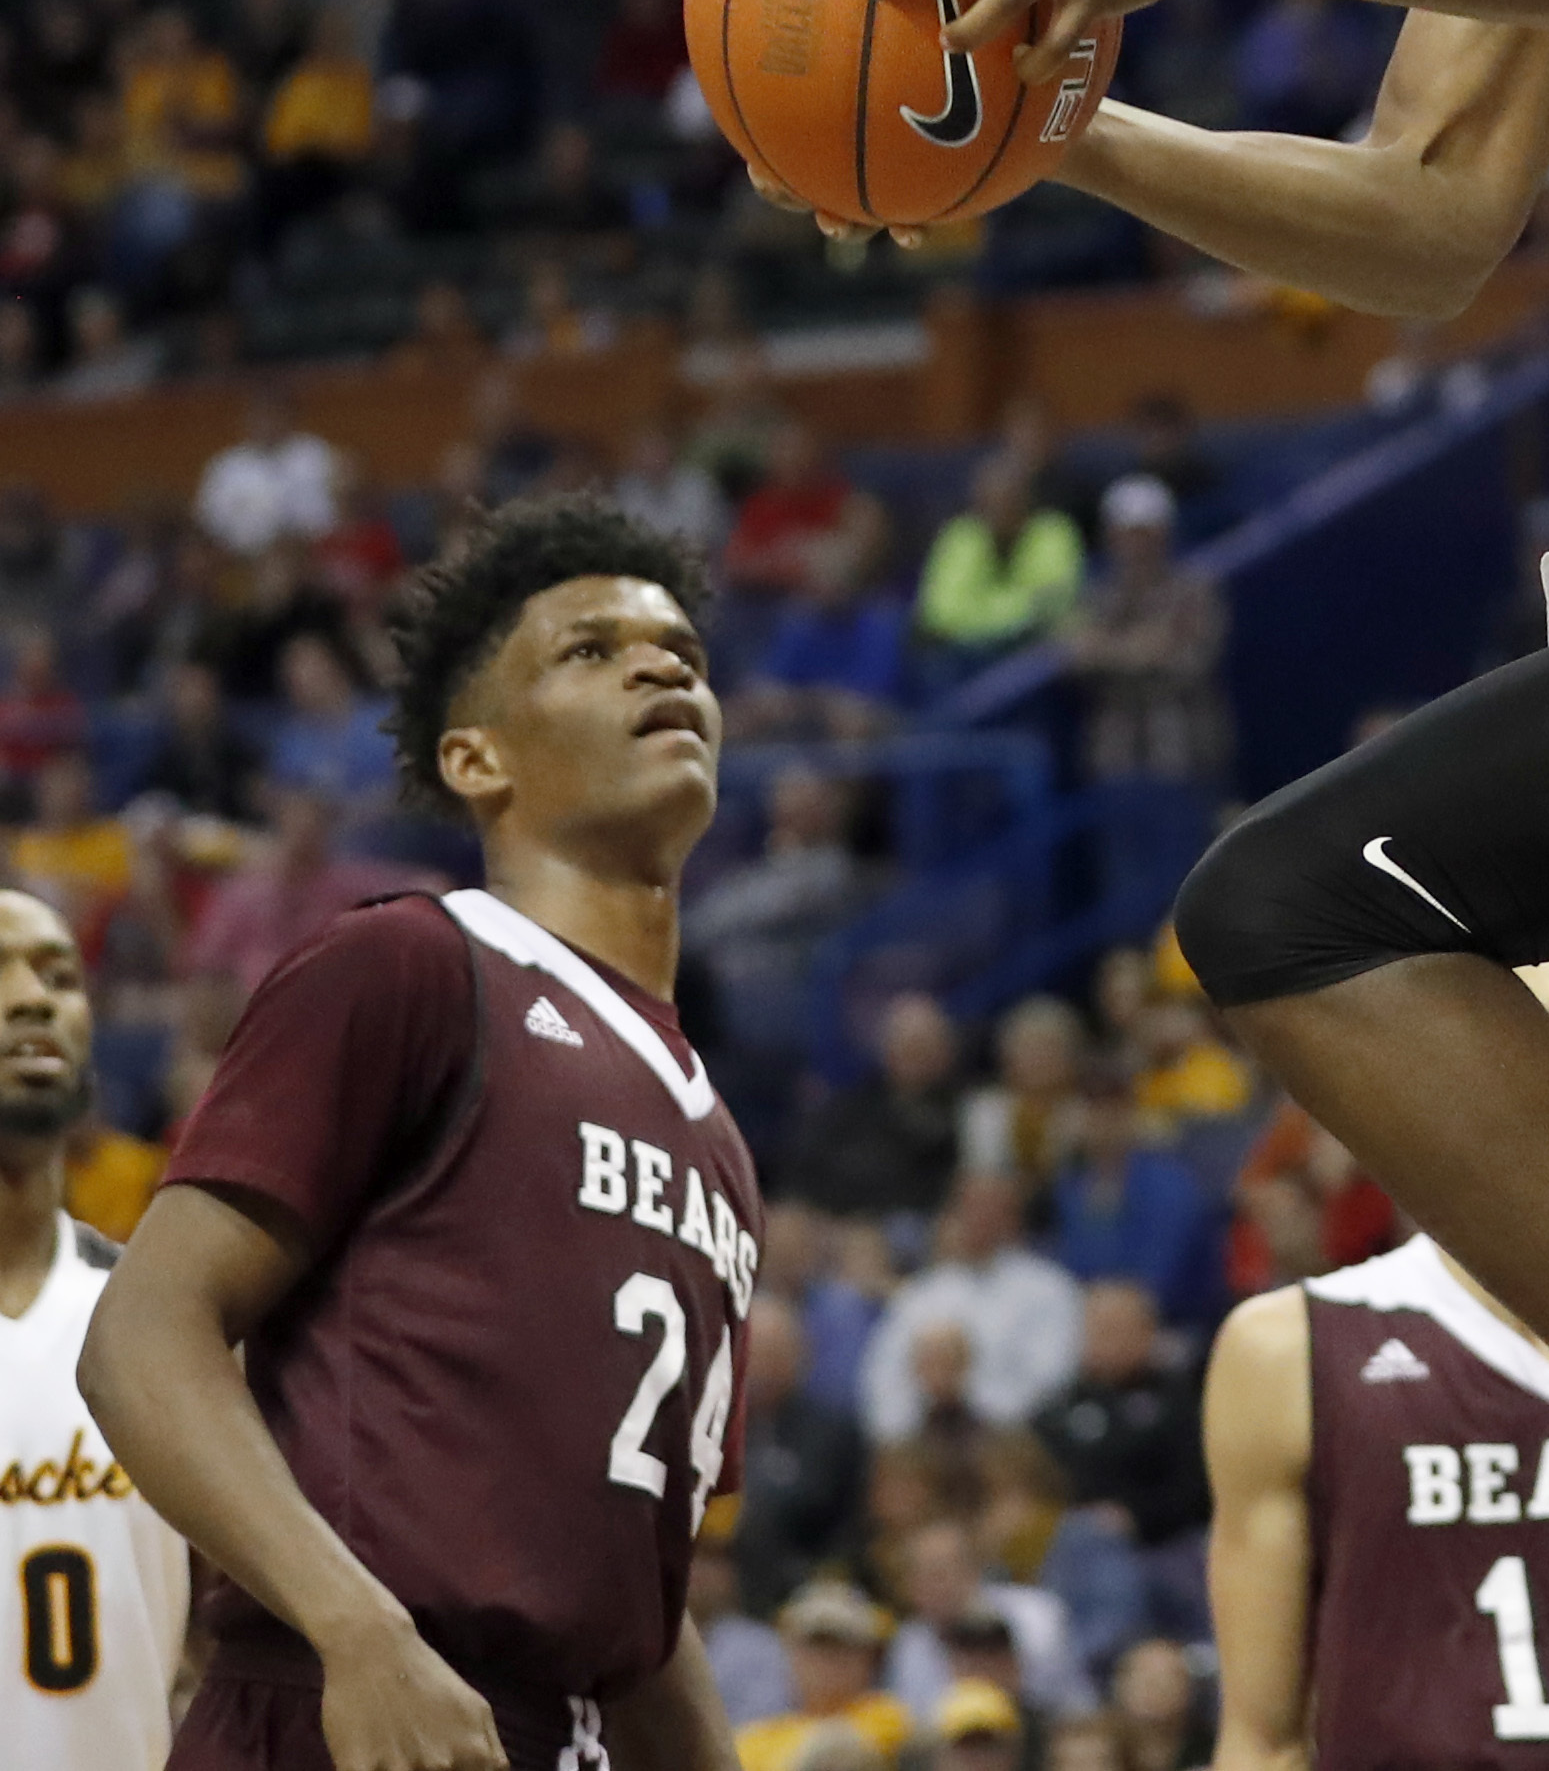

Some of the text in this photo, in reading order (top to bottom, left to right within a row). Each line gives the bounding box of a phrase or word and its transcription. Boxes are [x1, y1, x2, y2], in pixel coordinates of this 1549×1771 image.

[577, 1119, 760, 1321] BEARS
[606, 1270, 737, 1541] 24
[20, 1543, 98, 1695] 0
